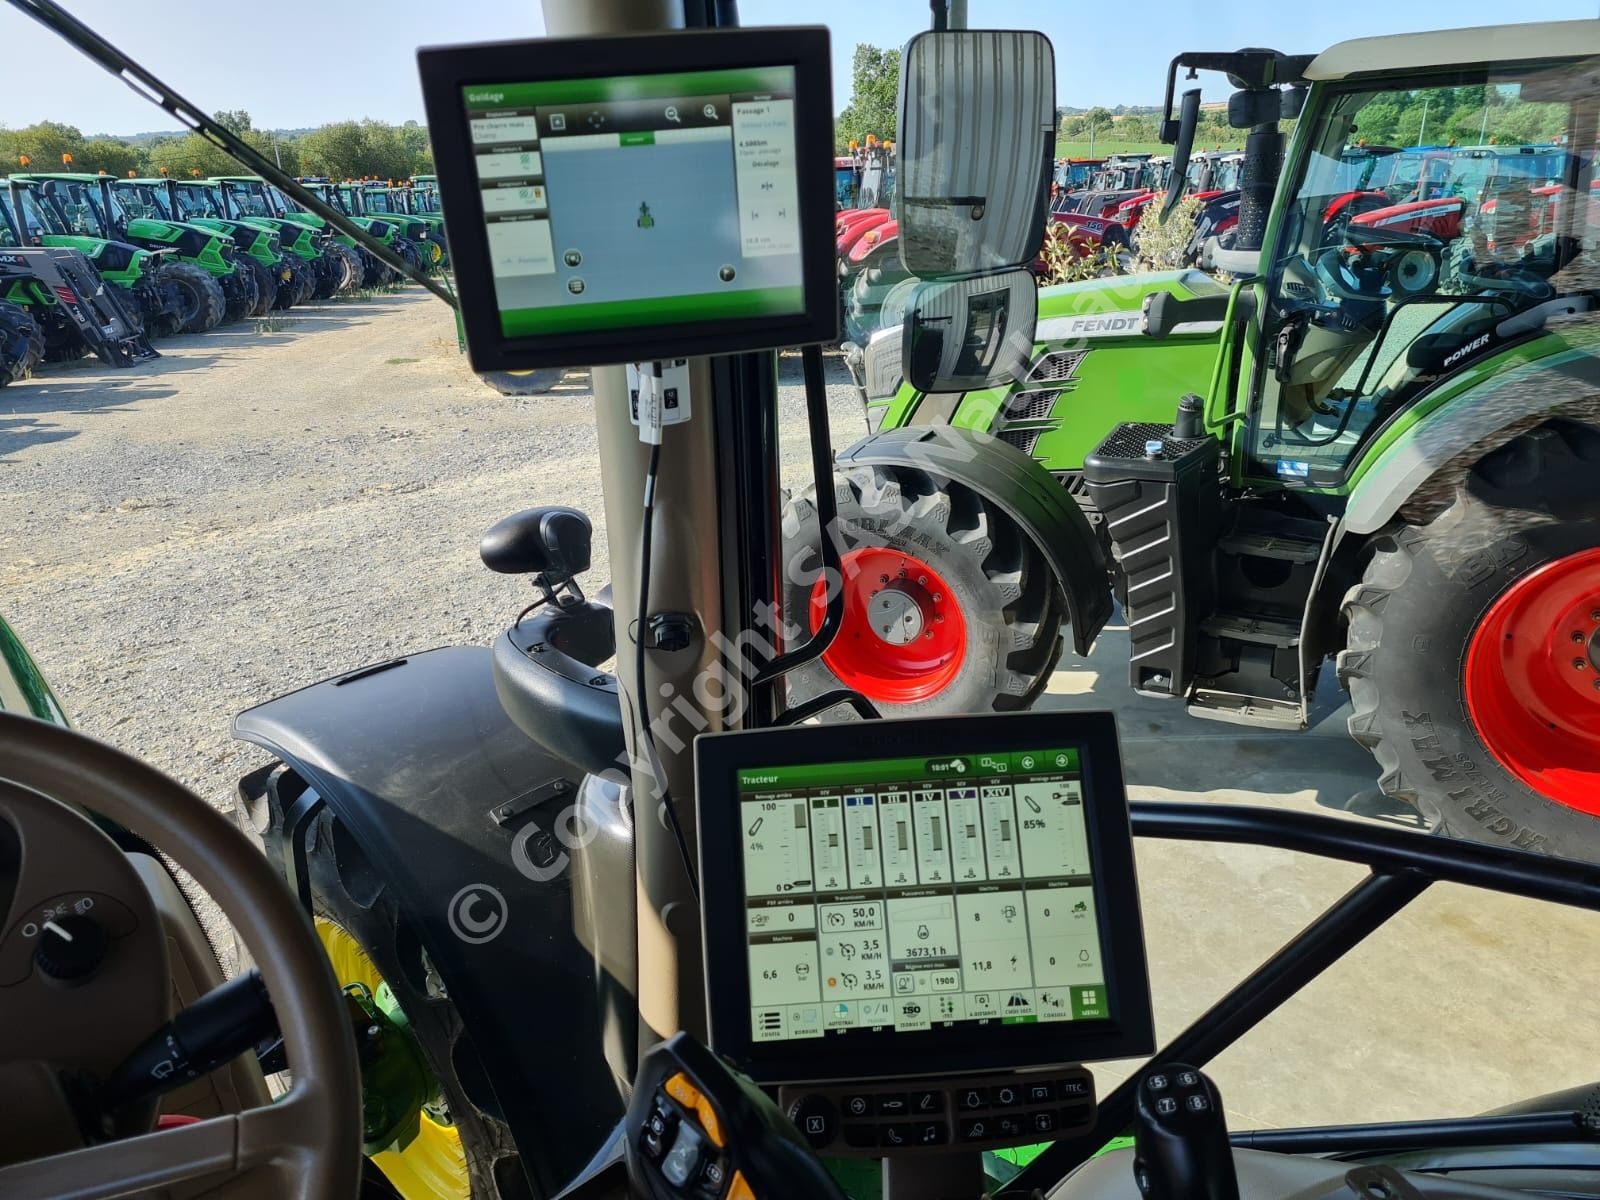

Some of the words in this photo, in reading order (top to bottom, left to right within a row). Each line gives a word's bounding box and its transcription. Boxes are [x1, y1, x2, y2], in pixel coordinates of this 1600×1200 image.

[1071, 316, 1140, 332] FENDT
[1443, 332, 1491, 368] POWER
[742, 775, 779, 785] Tracteur
[1401, 709, 1550, 853] AGRIMAX
[922, 792, 934, 801] IV
[986, 788, 1007, 798] XIV
[887, 795, 900, 803] III
[761, 803, 776, 811] 100
[1023, 819, 1046, 830] 85%
[750, 842, 764, 851] 4%
[776, 884, 782, 892] 0
[788, 913, 795, 922] 0
[852, 907, 875, 918] 50,0
[974, 913, 980, 922] 8
[1044, 908, 1050, 917] 0
[854, 919, 875, 928] KM/H
[863, 940, 879, 951] 3,5
[861, 952, 882, 960] KM/H
[906, 946, 937, 958] 3673,1
[940, 946, 946, 955] h
[972, 961, 993, 972] 11,8
[1050, 957, 1056, 966] 0
[763, 970, 778, 980] 6,6
[865, 970, 882, 981] 3,5
[935, 976, 955, 985] 1900
[863, 982, 884, 991] KM/H
[902, 1006, 921, 1015] ISO
[1154, 1077, 1162, 1088] 5
[1183, 1073, 1192, 1084] 6
[1162, 1099, 1169, 1111] 7
[1193, 1097, 1202, 1110] 8
